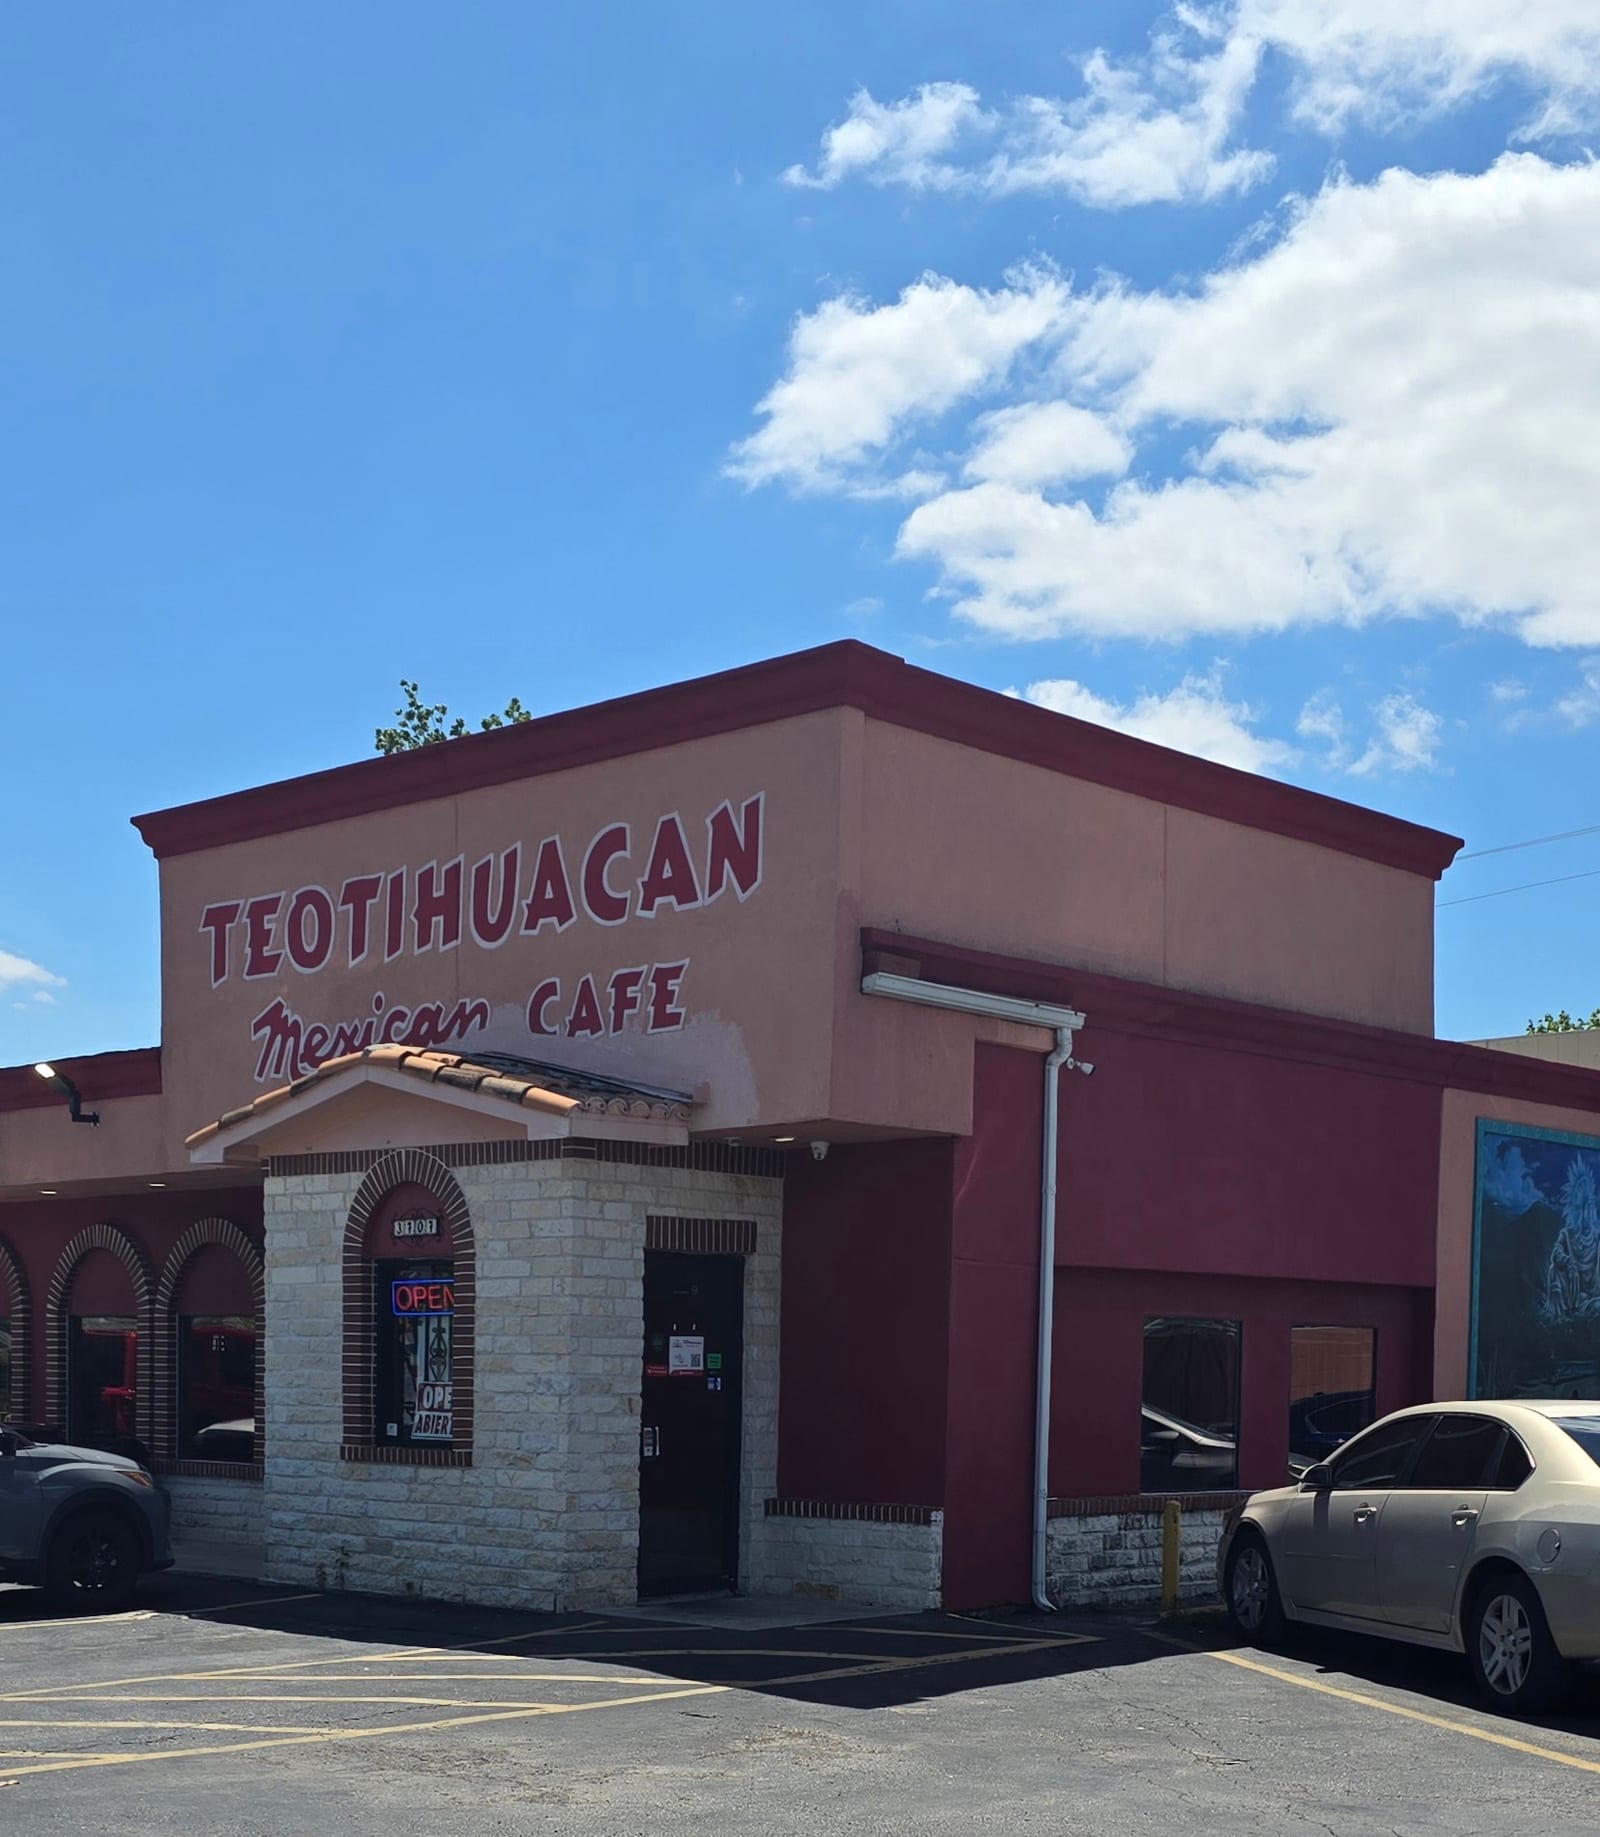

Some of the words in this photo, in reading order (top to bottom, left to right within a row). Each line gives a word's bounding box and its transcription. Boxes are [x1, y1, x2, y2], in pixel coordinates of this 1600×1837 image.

[199, 791, 765, 989] TEOTIHUACAN
[251, 991, 490, 1083] Mexican
[527, 958, 691, 1038] CAFE
[414, 1414, 453, 1435] ABIER
[423, 1385, 453, 1409] OPE
